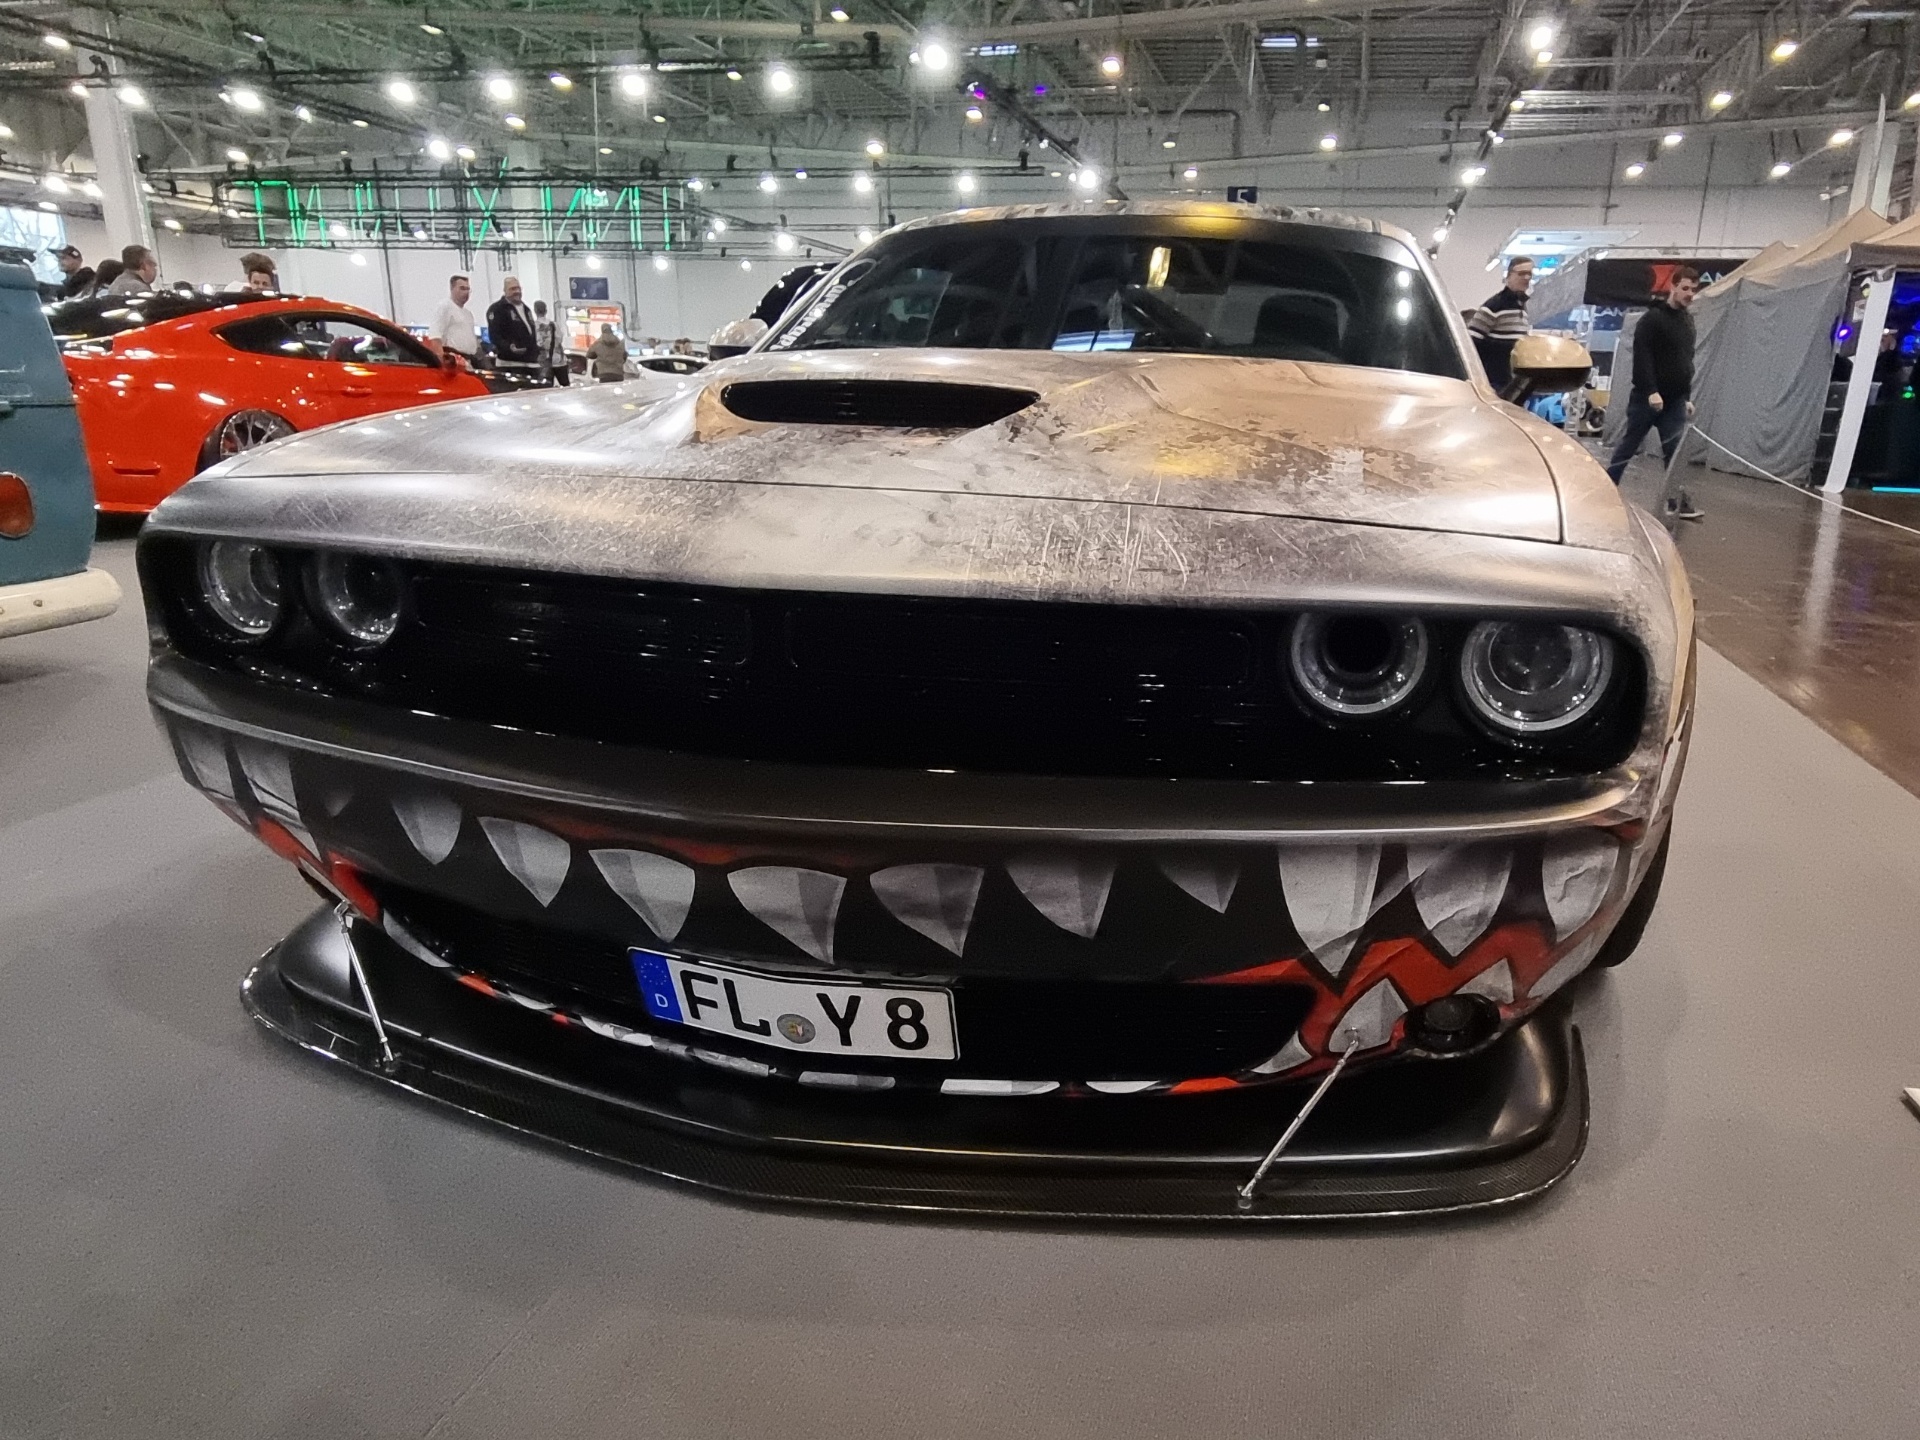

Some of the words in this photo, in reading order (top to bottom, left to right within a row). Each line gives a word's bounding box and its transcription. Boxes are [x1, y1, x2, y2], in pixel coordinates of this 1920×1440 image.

[655, 993, 668, 1007] D
[679, 969, 772, 1037] FL
[816, 992, 862, 1047] Y
[885, 997, 930, 1051] 8
